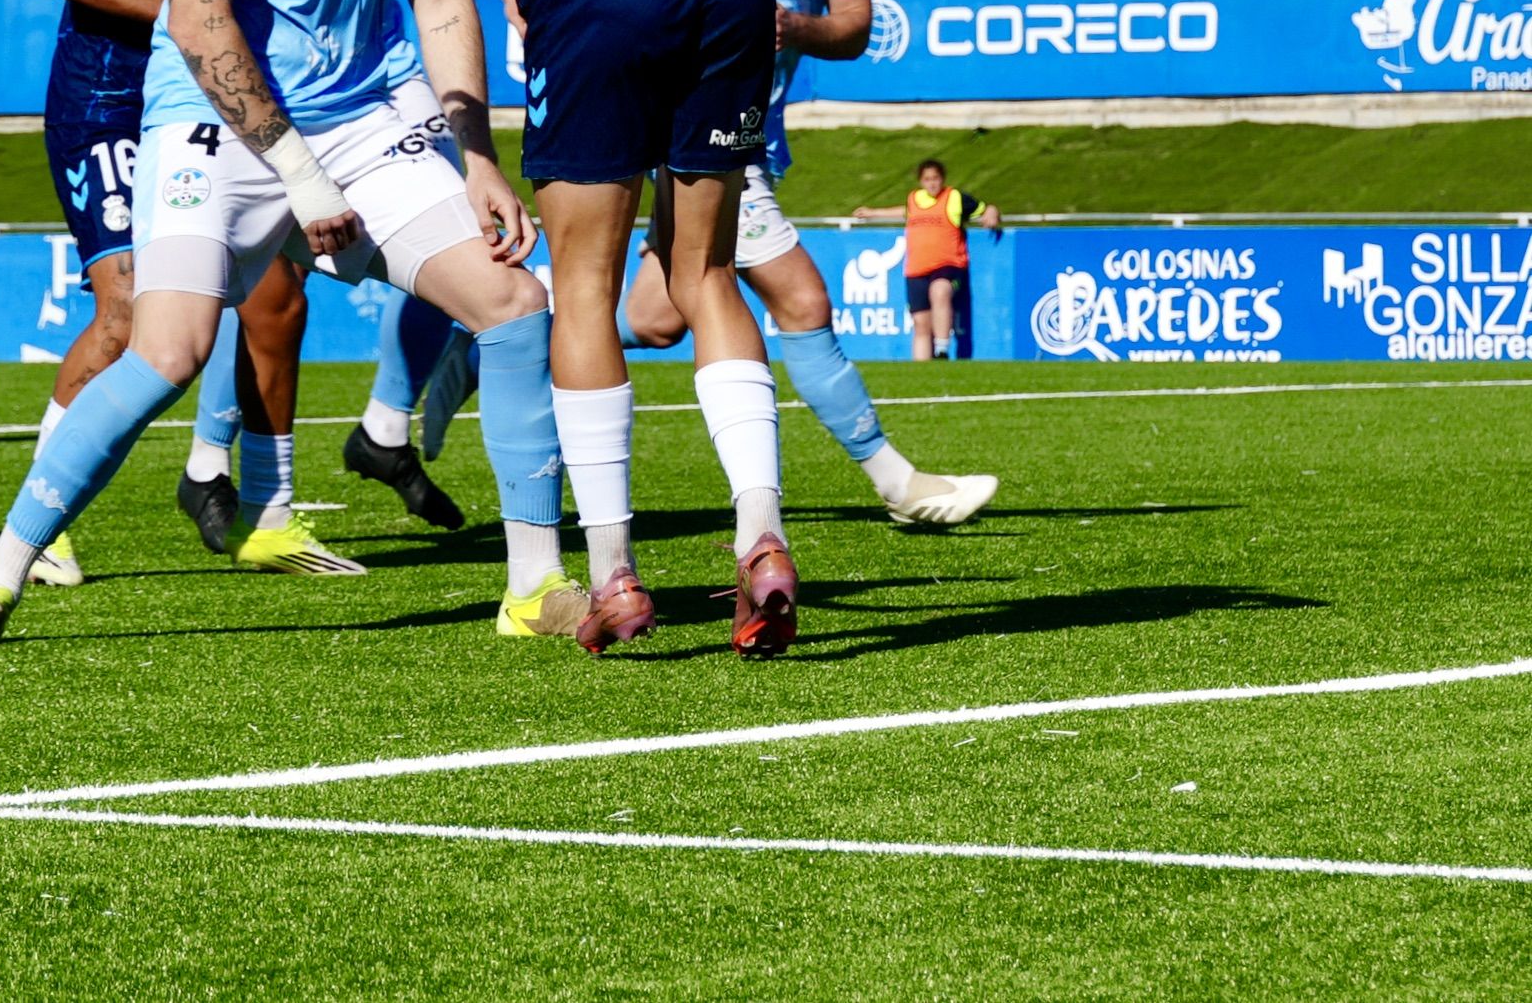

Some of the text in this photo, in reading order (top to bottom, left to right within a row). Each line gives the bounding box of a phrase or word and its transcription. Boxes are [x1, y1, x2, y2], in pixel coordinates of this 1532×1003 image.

[926, 1, 1218, 57] CORECO
[187, 122, 220, 157] 4
[90, 138, 139, 193] 16
[1103, 248, 1256, 280] GOLOSINAS
[861, 308, 900, 336] DEL
[1056, 271, 1283, 343] PAREDES
